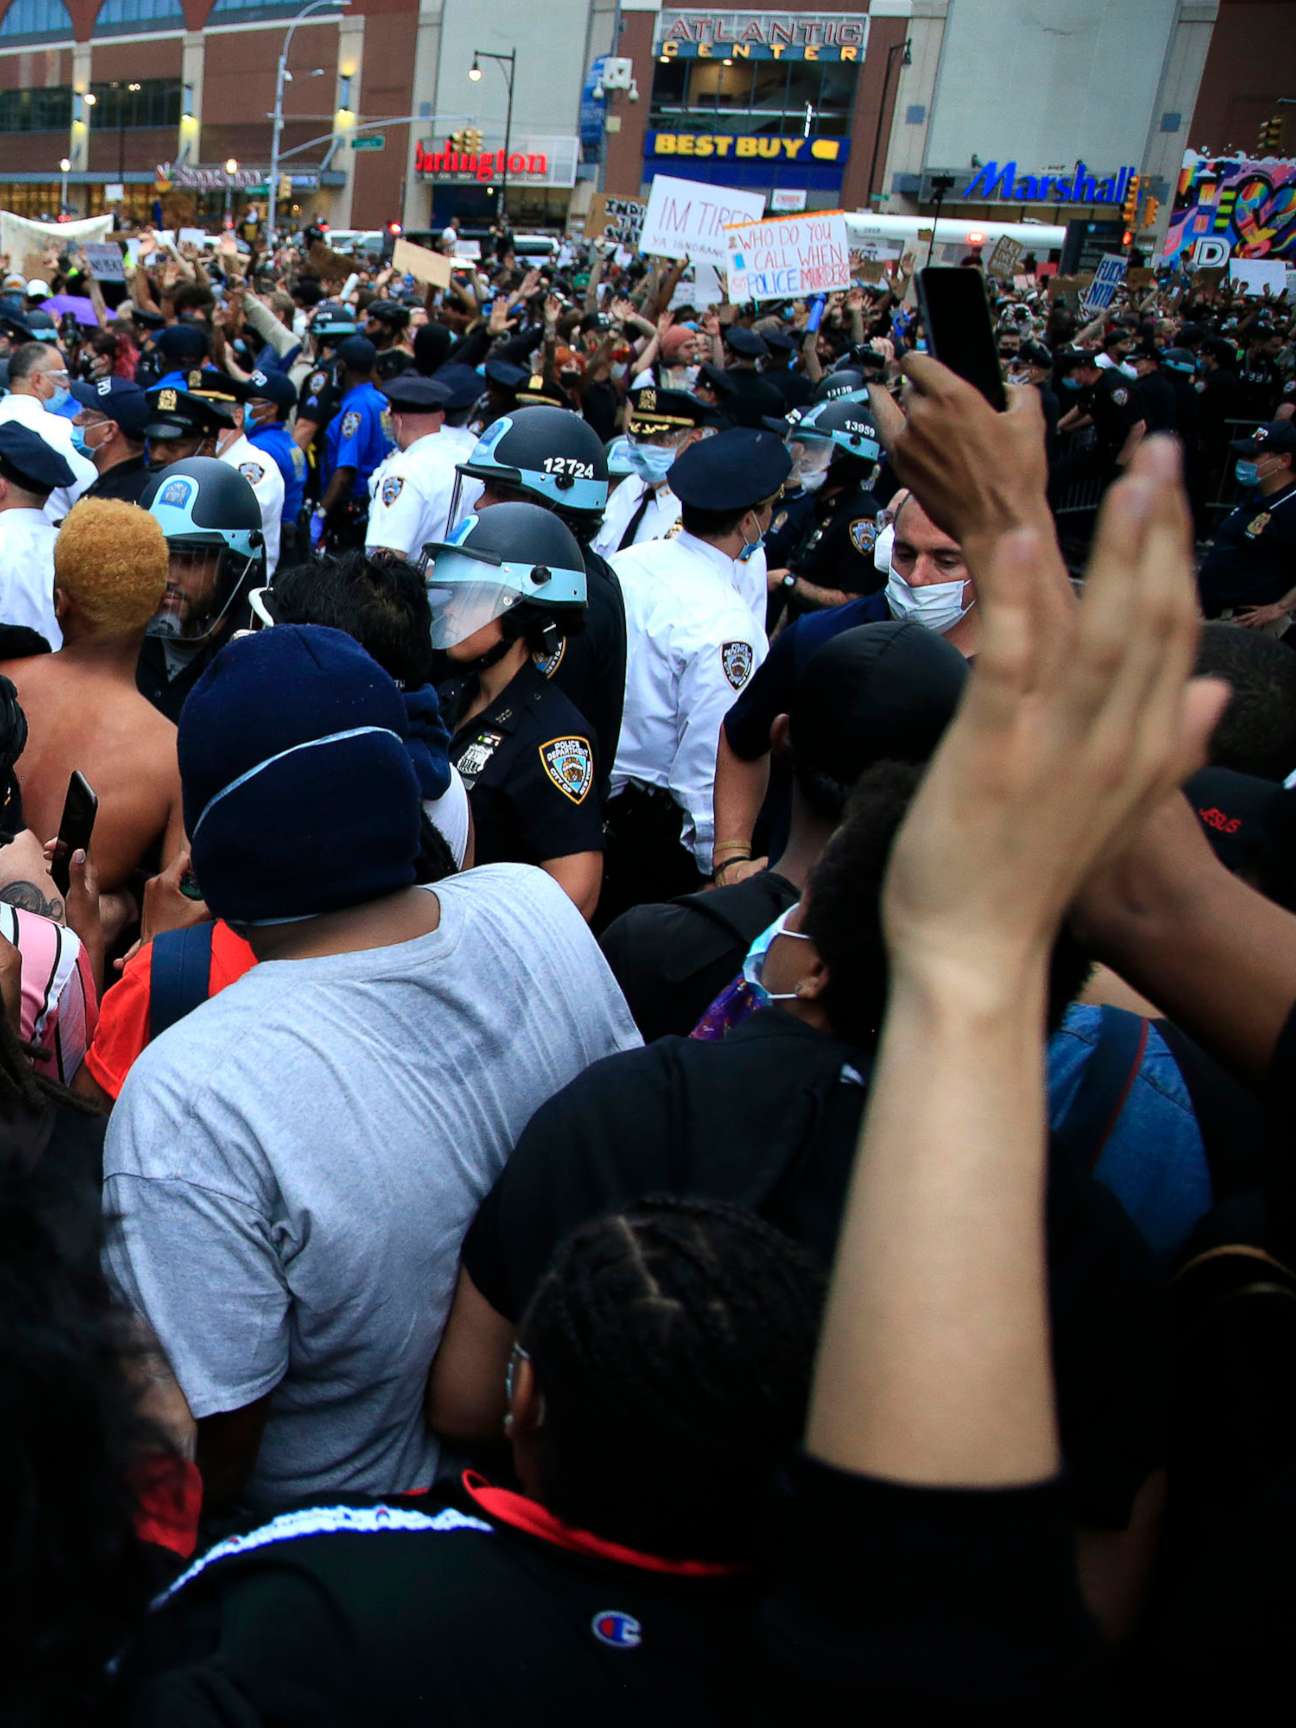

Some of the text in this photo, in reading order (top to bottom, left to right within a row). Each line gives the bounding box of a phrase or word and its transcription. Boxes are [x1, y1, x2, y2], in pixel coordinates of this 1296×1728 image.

[665, 16, 864, 46] ATLANTIC
[662, 40, 859, 62] CENTER
[655, 133, 805, 159] BEST BUY
[962, 160, 1143, 204] Marshall
[659, 196, 692, 233] IM
[738, 222, 832, 250] WHO DO YOU
[754, 249, 794, 271] CALL
[798, 241, 845, 268] WHEN
[747, 268, 799, 296] POLICE
[543, 456, 594, 479] 12724
[554, 740, 580, 750] POLICE
